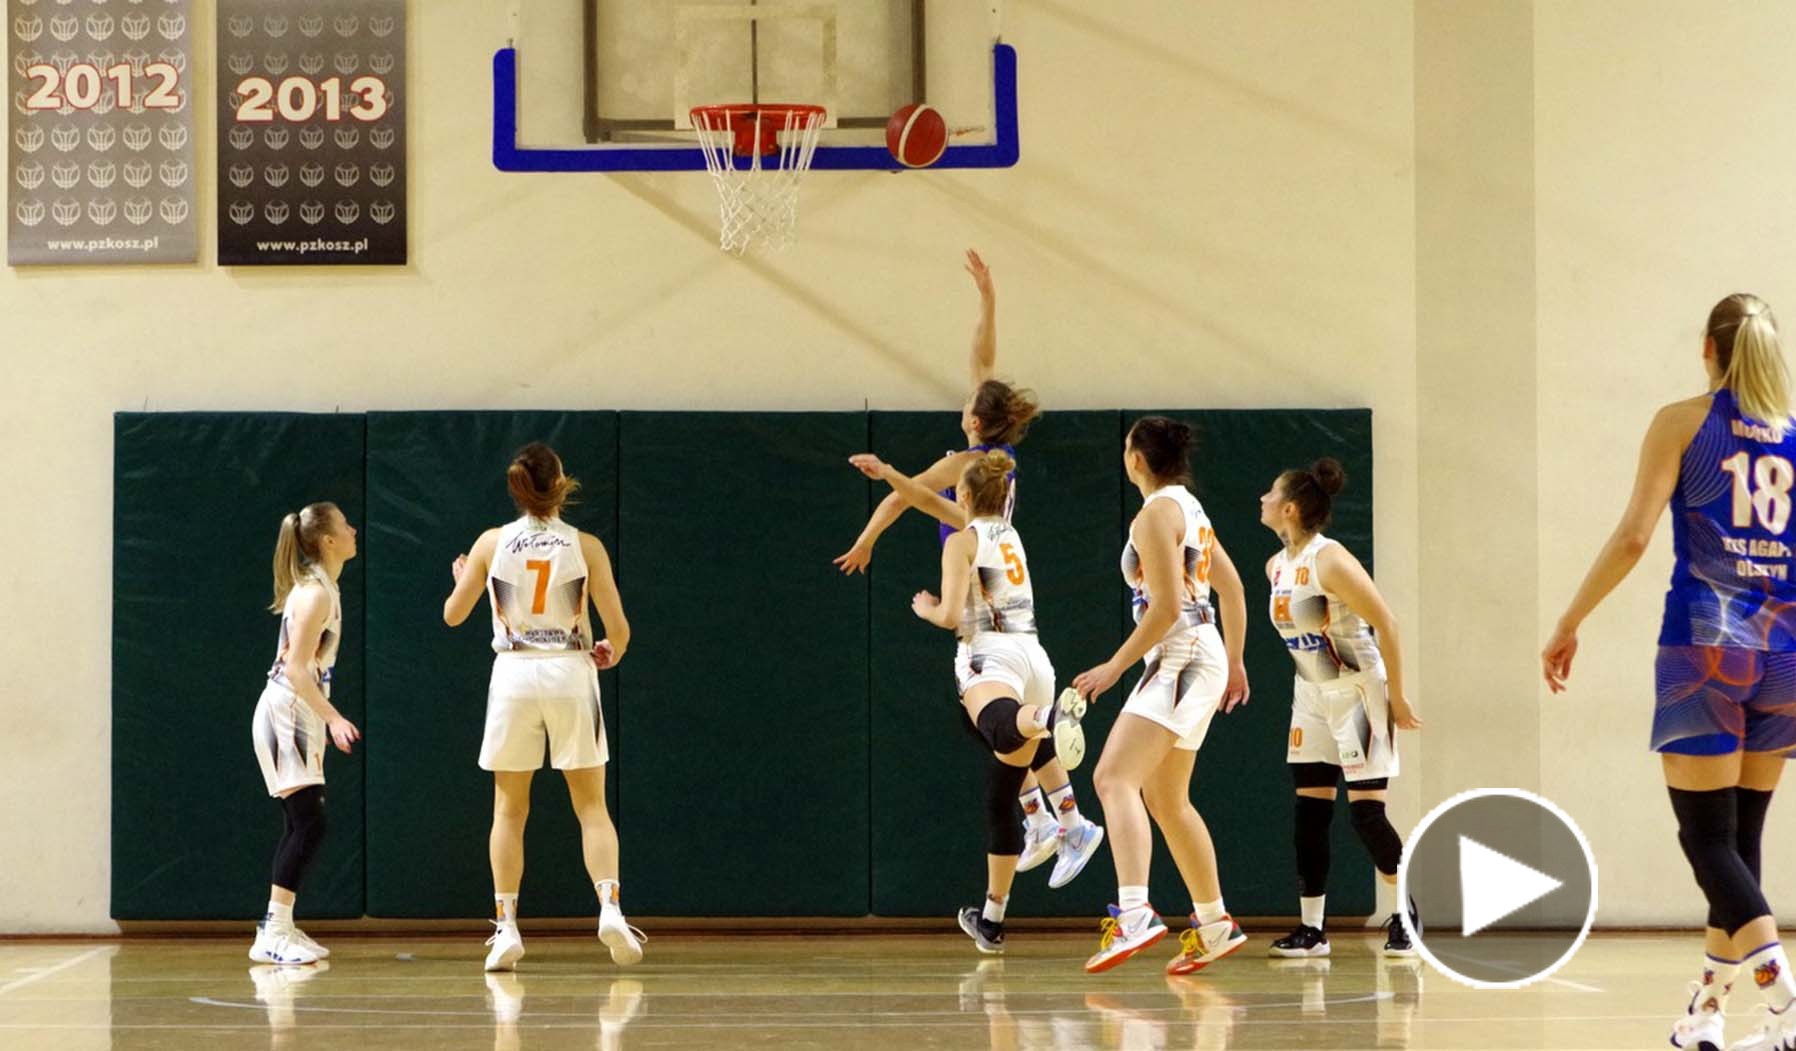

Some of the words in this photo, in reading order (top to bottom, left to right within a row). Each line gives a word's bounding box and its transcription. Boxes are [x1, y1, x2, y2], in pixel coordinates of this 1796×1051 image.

[26, 63, 180, 110] 2012
[236, 76, 388, 123] 2013
[47, 236, 159, 252] www.pzkosz.pl
[256, 238, 368, 254] www.pzkosz.pl
[1721, 451, 1794, 536] 18
[526, 560, 551, 614] 7
[999, 543, 1025, 586] 5
[1295, 567, 1309, 586] 10
